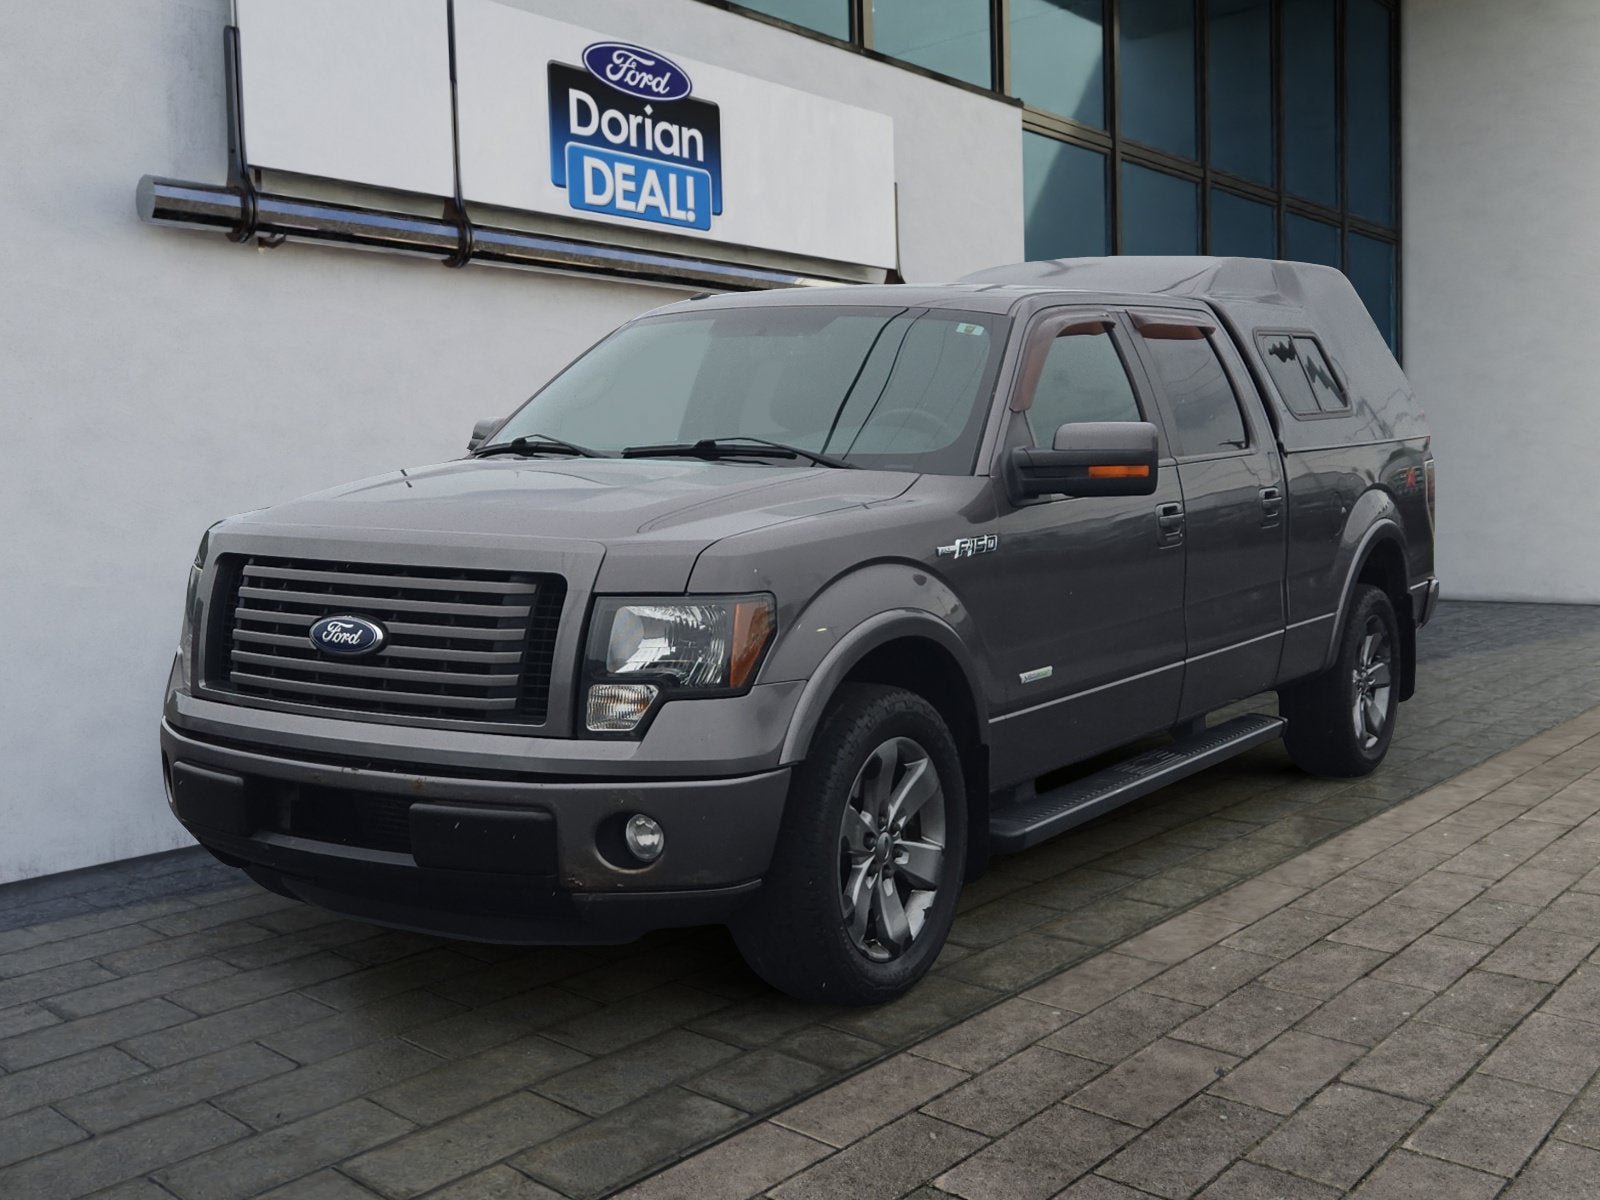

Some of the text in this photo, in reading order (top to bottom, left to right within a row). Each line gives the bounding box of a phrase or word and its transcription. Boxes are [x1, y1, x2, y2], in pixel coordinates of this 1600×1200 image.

[606, 50, 671, 94] Ford
[568, 87, 704, 162] Dorian
[583, 155, 696, 223] DEAL!
[322, 621, 363, 645] Ford
